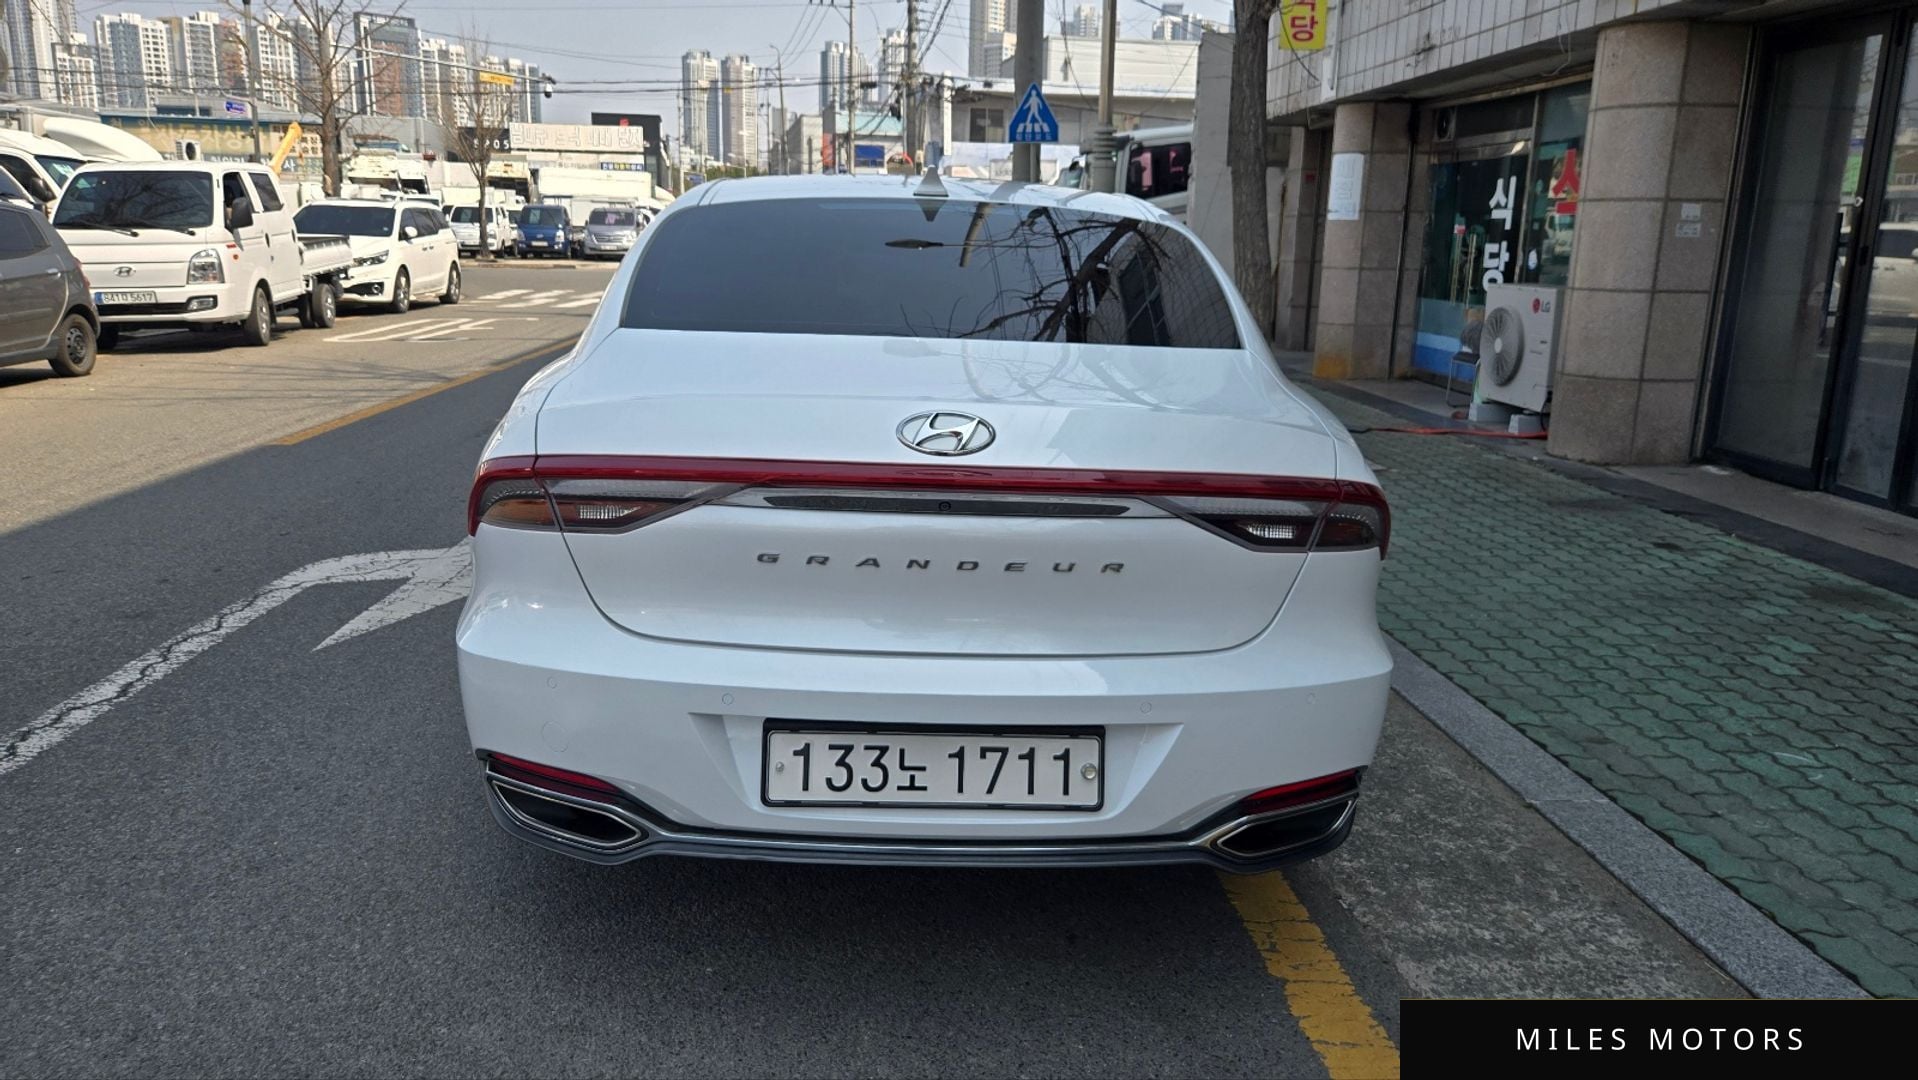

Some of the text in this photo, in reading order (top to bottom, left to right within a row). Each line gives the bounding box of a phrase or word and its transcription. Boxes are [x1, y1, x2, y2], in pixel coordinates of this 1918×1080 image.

[1290, 0, 1319, 42] 당
[1483, 175, 1517, 292] 식당
[1541, 300, 1551, 313] LG
[756, 553, 1126, 574] GRANDEUR
[792, 742, 1071, 796] 133노 1711
